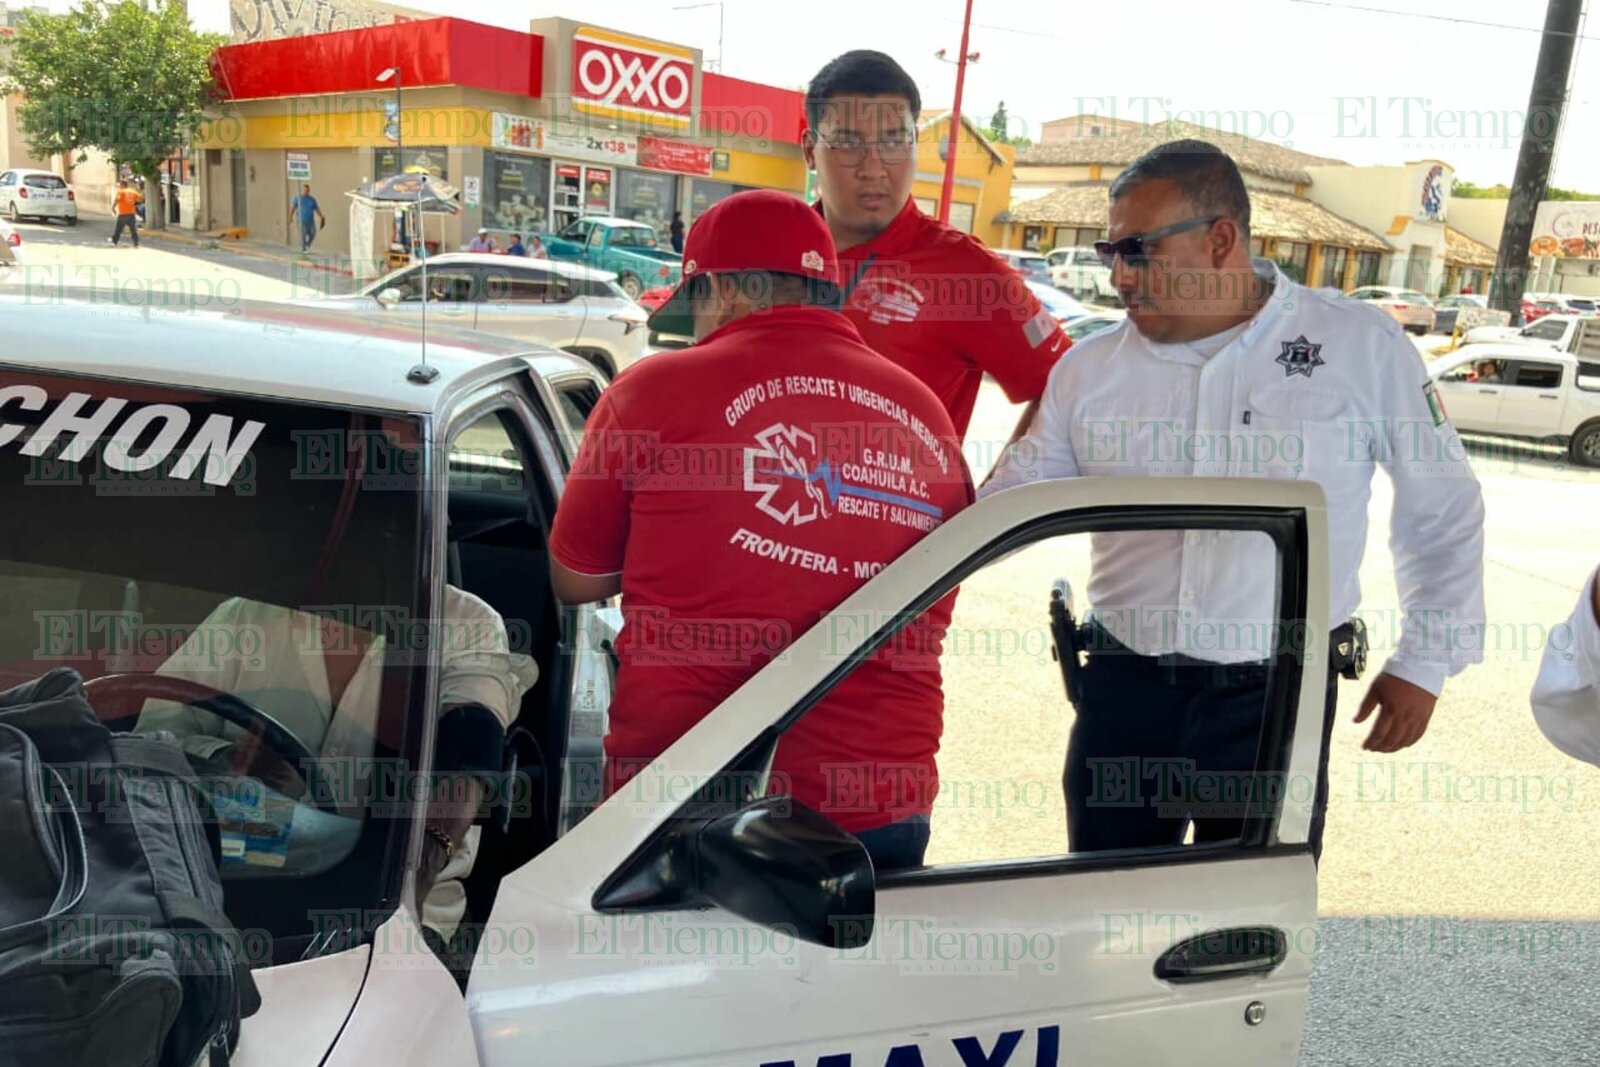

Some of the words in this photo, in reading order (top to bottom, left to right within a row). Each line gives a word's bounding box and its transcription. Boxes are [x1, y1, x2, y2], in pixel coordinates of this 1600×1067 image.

[579, 46, 689, 109] OXXO
[724, 383, 766, 428] GRUPO
[766, 378, 783, 399] DE
[785, 376, 836, 398] RESCATE
[838, 381, 845, 399] Y
[849, 382, 909, 427] URGENCIAS
[842, 462, 907, 492] COAHUILA
[909, 478, 930, 499] A.C.
[863, 447, 914, 475] G.R.U.M.
[838, 495, 880, 519] RESCATE
[882, 506, 889, 520] Y
[729, 528, 839, 574] FRONTERA
[853, 561, 887, 579] MO
